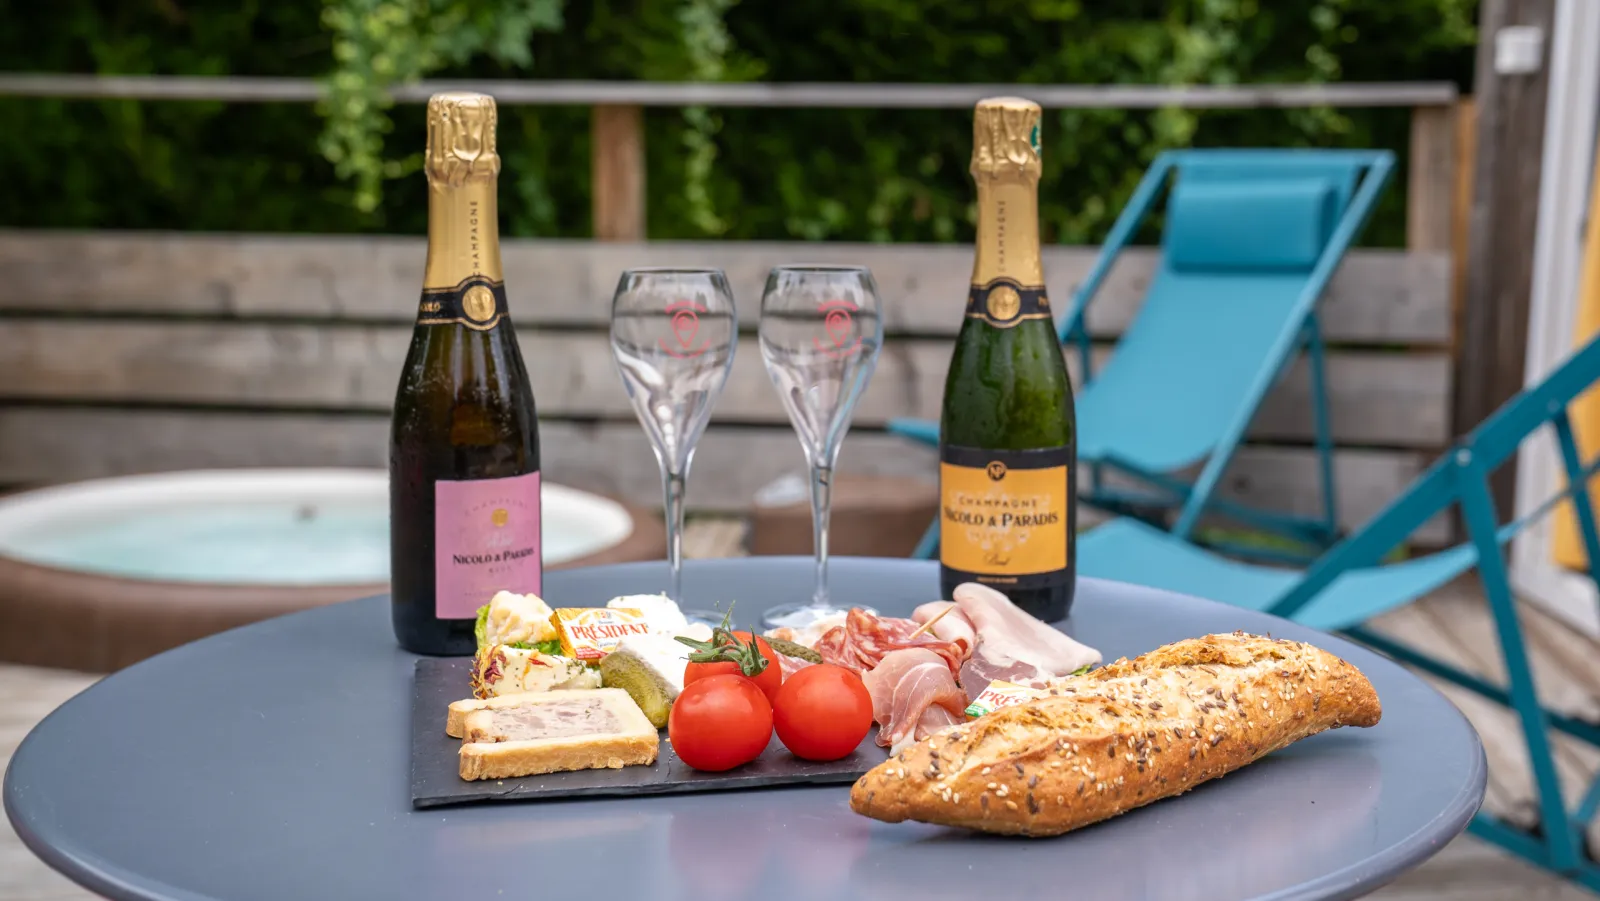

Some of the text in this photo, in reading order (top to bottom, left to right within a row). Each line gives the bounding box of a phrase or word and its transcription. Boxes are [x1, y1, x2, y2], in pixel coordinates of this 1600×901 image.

[959, 496, 1038, 509] CHAMPAGNE
[1002, 511, 1059, 527] PARADIS
[452, 553, 493, 566] NICOLO
[570, 623, 648, 641] PRÉSIDENT
